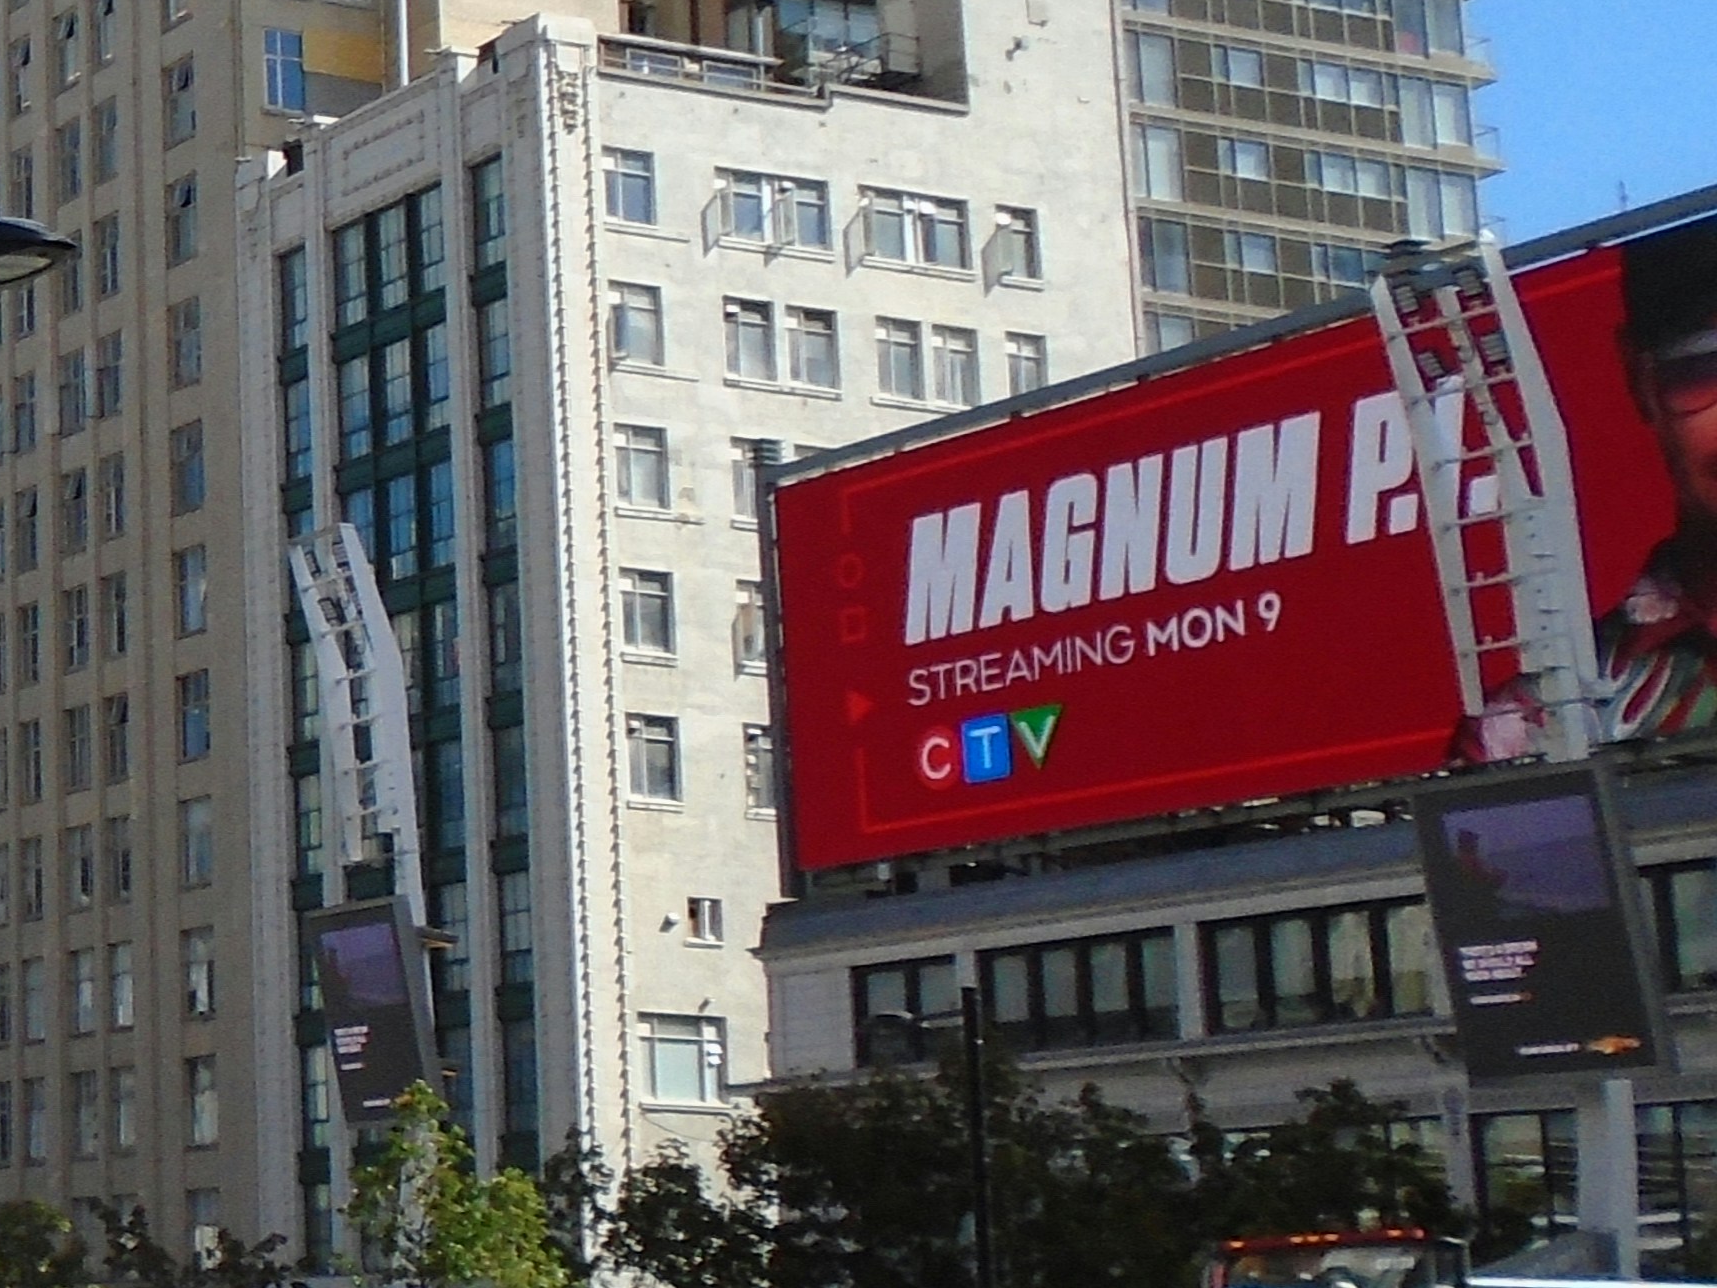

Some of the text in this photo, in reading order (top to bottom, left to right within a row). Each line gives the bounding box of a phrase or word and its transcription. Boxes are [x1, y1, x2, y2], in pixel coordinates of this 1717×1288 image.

[903, 411, 1322, 647] MAGNUM
[907, 591, 1282, 706] STREAMING MON 9
[918, 710, 1059, 784] CTV
